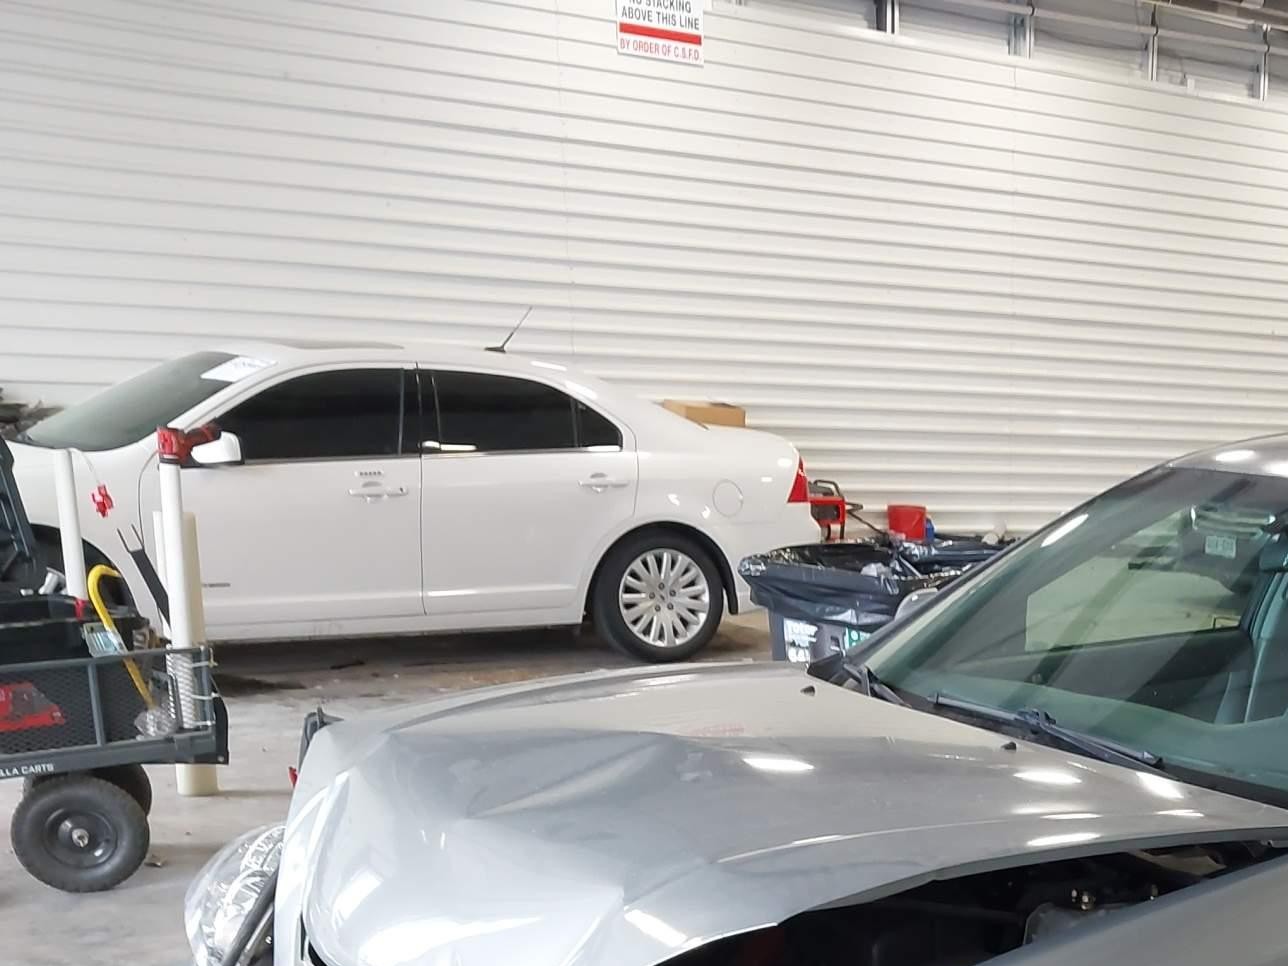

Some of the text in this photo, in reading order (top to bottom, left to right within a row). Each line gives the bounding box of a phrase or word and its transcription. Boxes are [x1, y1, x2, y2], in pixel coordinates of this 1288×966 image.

[646, 0, 692, 13] STACKING
[621, 5, 700, 31] ABOVE THIS LINE
[620, 38, 630, 49] BY
[632, 39, 660, 55] ORDER
[662, 43, 672, 57] OF
[21, 763, 54, 774] CARTS
